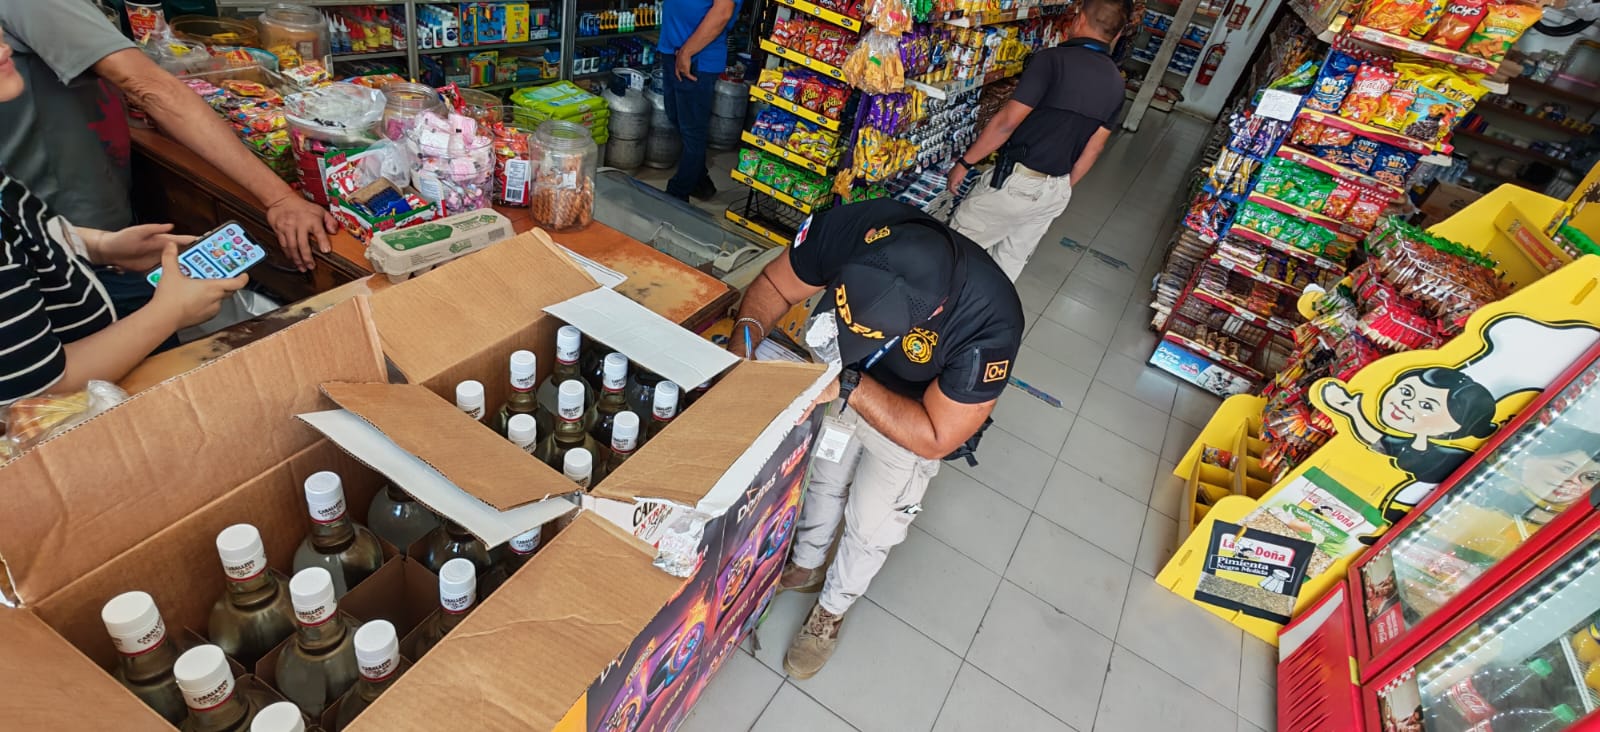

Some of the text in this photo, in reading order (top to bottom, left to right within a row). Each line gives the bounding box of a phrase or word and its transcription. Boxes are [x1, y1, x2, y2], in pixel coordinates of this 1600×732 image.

[1222, 538, 1286, 562] La Doña
[1217, 556, 1269, 571] Pimienta
[1240, 566, 1268, 576] Molida
